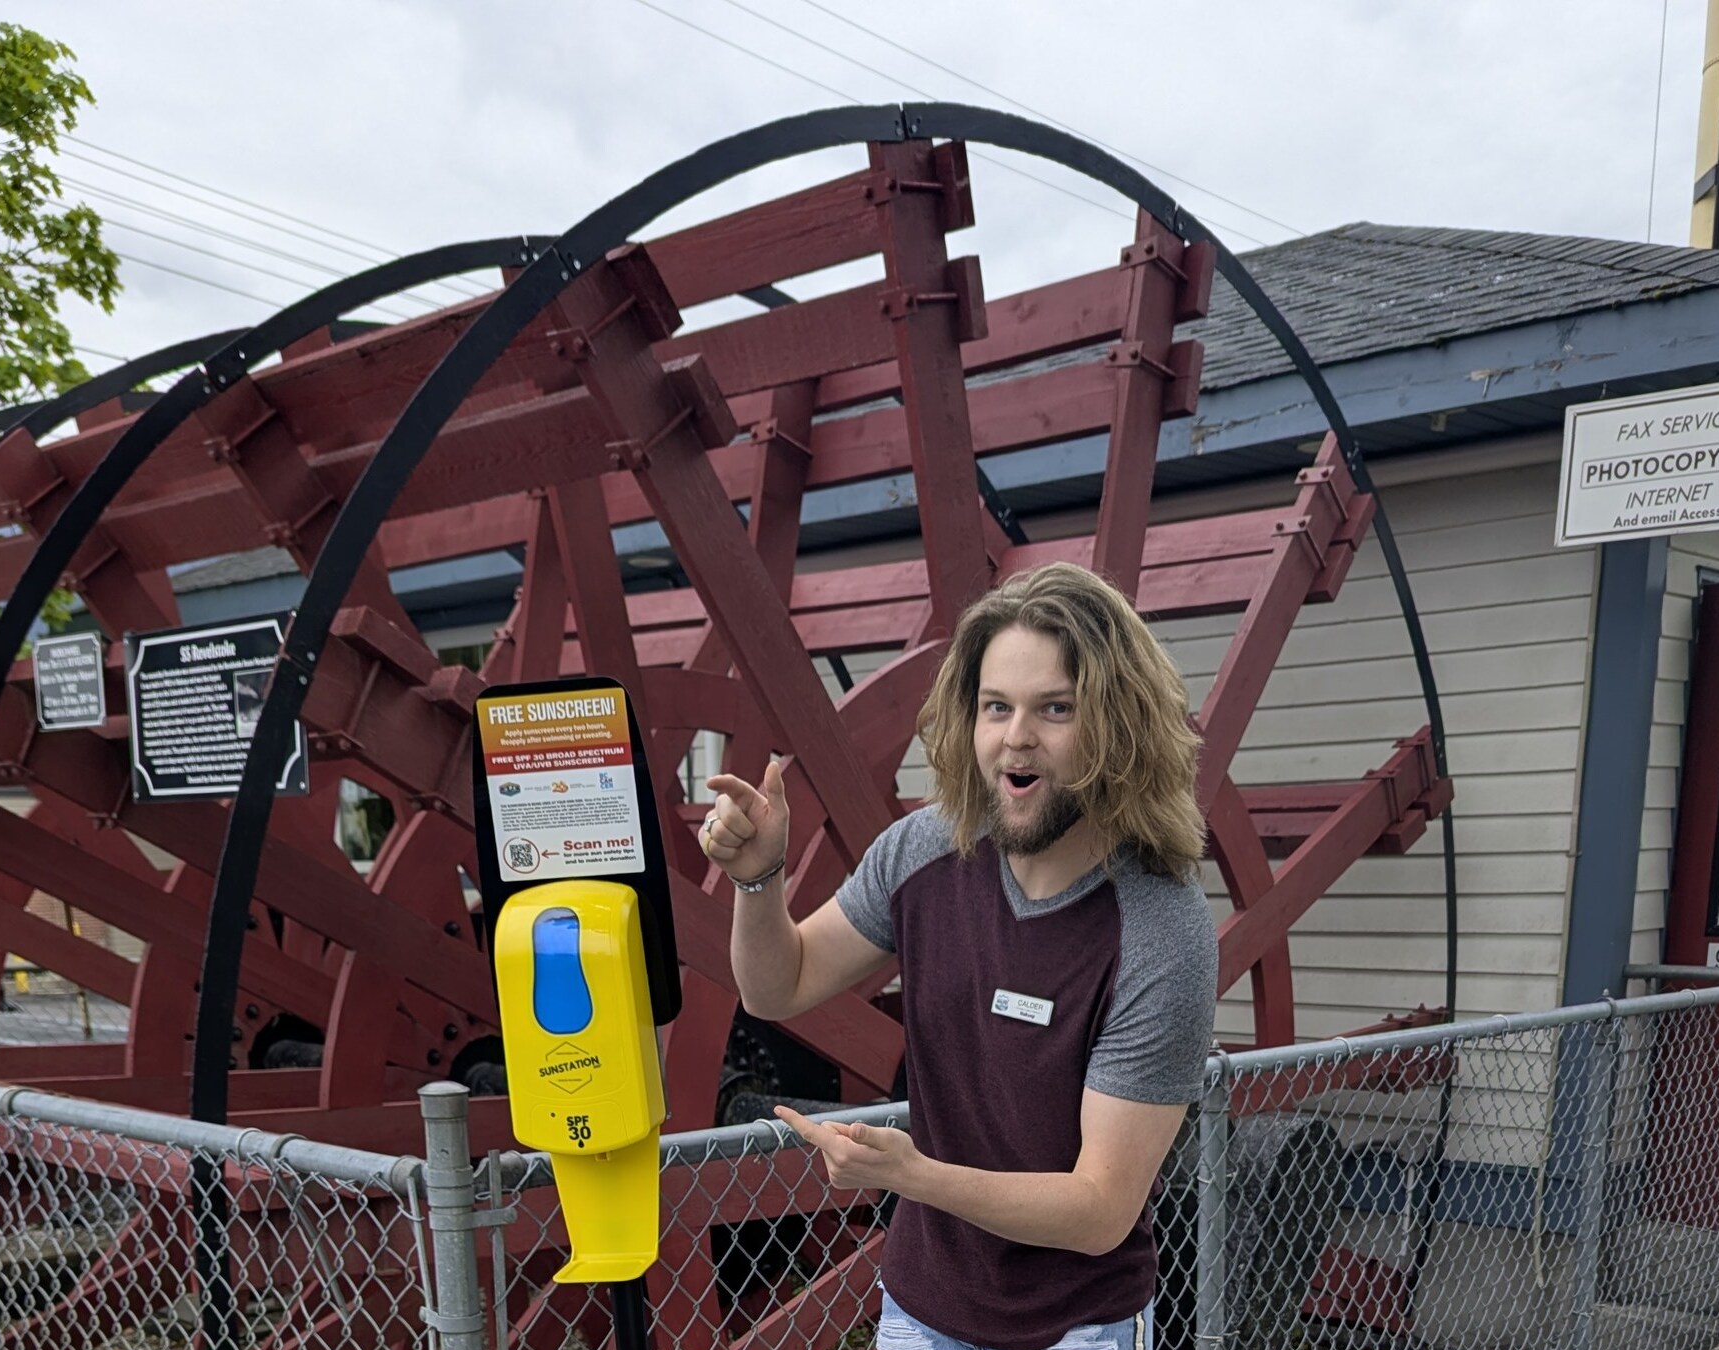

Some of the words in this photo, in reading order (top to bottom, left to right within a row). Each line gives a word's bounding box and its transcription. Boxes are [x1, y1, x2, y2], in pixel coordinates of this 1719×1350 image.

[1616, 420, 1654, 442] FAX
[1625, 483, 1713, 509] INTERNET
[1613, 515, 1639, 528] And
[1641, 509, 1676, 526] email
[488, 704, 524, 725] FREE
[527, 697, 616, 722] SUNSCREEN!
[500, 737, 526, 747] Reapply
[527, 736, 542, 744] after
[543, 733, 575, 743] swimming
[505, 729, 523, 738] Apply
[524, 727, 555, 736] sunscreen
[555, 726, 573, 734] every
[491, 756, 514, 765] FREE
[515, 755, 532, 763] SPF
[546, 751, 577, 761] BROAD
[577, 746, 625, 758] SPECTRUM
[513, 761, 553, 771] UVA/UVB
[554, 757, 605, 768] SUNSCREEN
[563, 840, 602, 851] Scan
[606, 835, 635, 848] me!
[1017, 999, 1044, 1011] CALDER
[539, 1055, 600, 1077] SUNSTATION
[566, 1115, 589, 1127] SPF
[568, 1126, 591, 1140] 30
